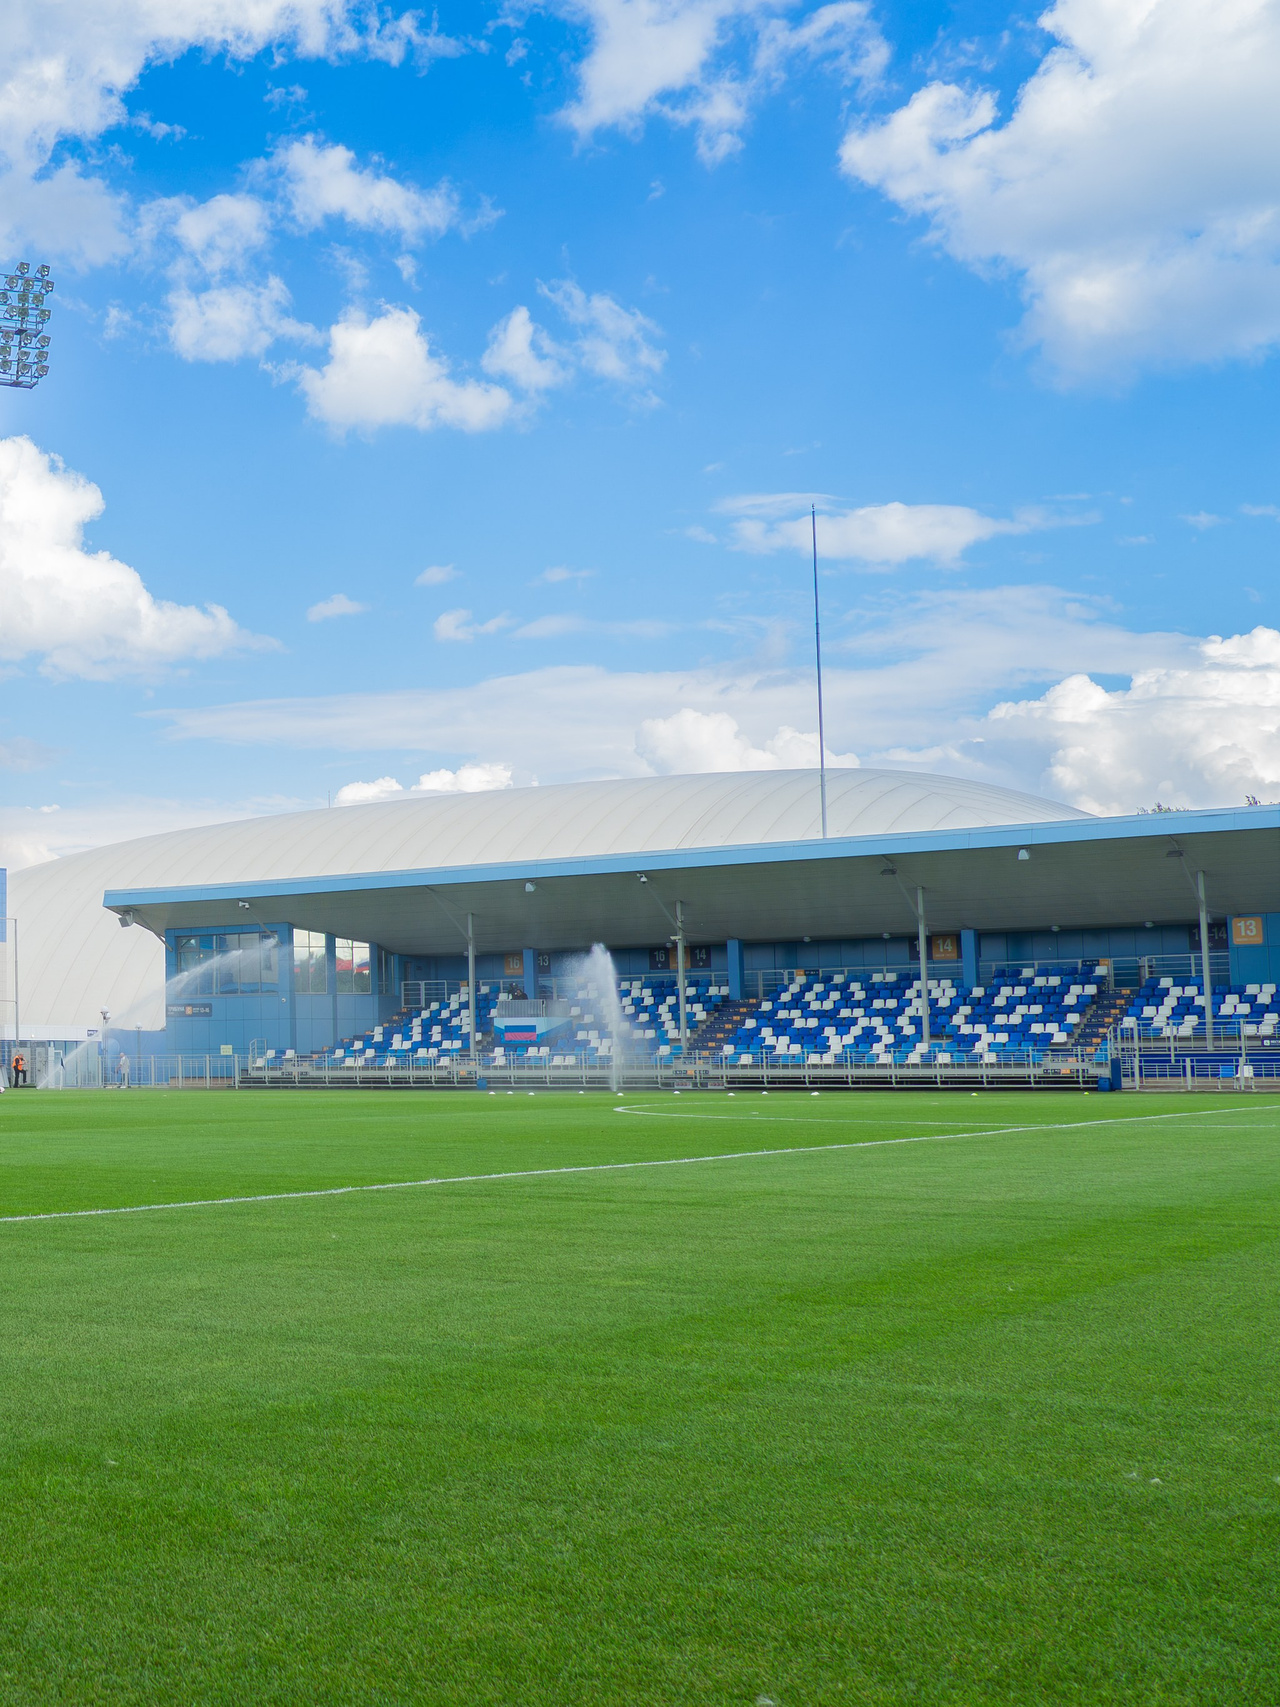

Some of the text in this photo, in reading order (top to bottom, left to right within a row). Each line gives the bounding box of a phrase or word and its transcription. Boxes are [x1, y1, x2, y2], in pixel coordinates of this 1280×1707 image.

[1237, 920, 1257, 936] 13
[936, 938, 953, 952] 14
[654, 950, 666, 962] 16
[694, 948, 707, 960] 14
[507, 956, 520, 969] 16
